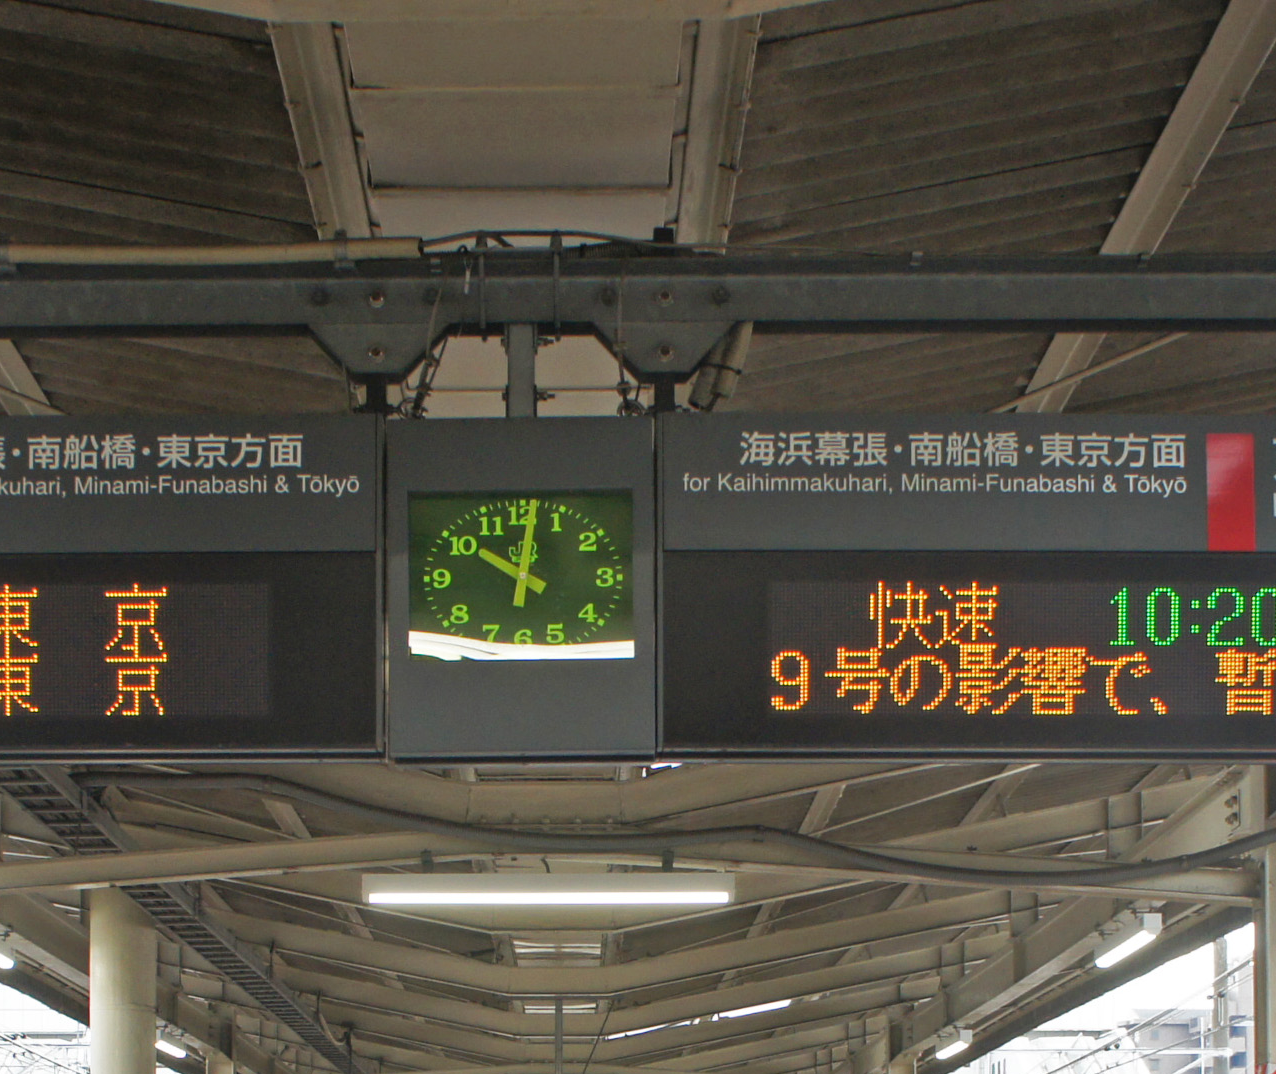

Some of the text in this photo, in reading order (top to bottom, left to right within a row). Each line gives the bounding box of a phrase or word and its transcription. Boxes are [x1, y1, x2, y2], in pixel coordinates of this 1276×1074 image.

[739, 430, 1187, 468] 海浜幕張・南船橋・東京方面
[74, 475, 268, 497] Minami-Funabashi
[274, 475, 290, 496] &
[682, 472, 712, 493] for
[717, 471, 894, 496] Kaihimmakuhari,
[901, 472, 1096, 494] Minami-Funabashi
[1102, 474, 1119, 495] &
[479, 516, 504, 536] 11
[508, 506, 537, 526] 12
[550, 513, 562, 532] 1
[449, 535, 478, 556] 10
[578, 532, 598, 552] 2
[432, 568, 452, 589] 9
[595, 567, 615, 587] 3
[450, 604, 470, 625] 8
[578, 603, 598, 623] 4
[869, 580, 1001, 651] 快速
[482, 624, 500, 643] 7
[546, 623, 565, 645] 5
